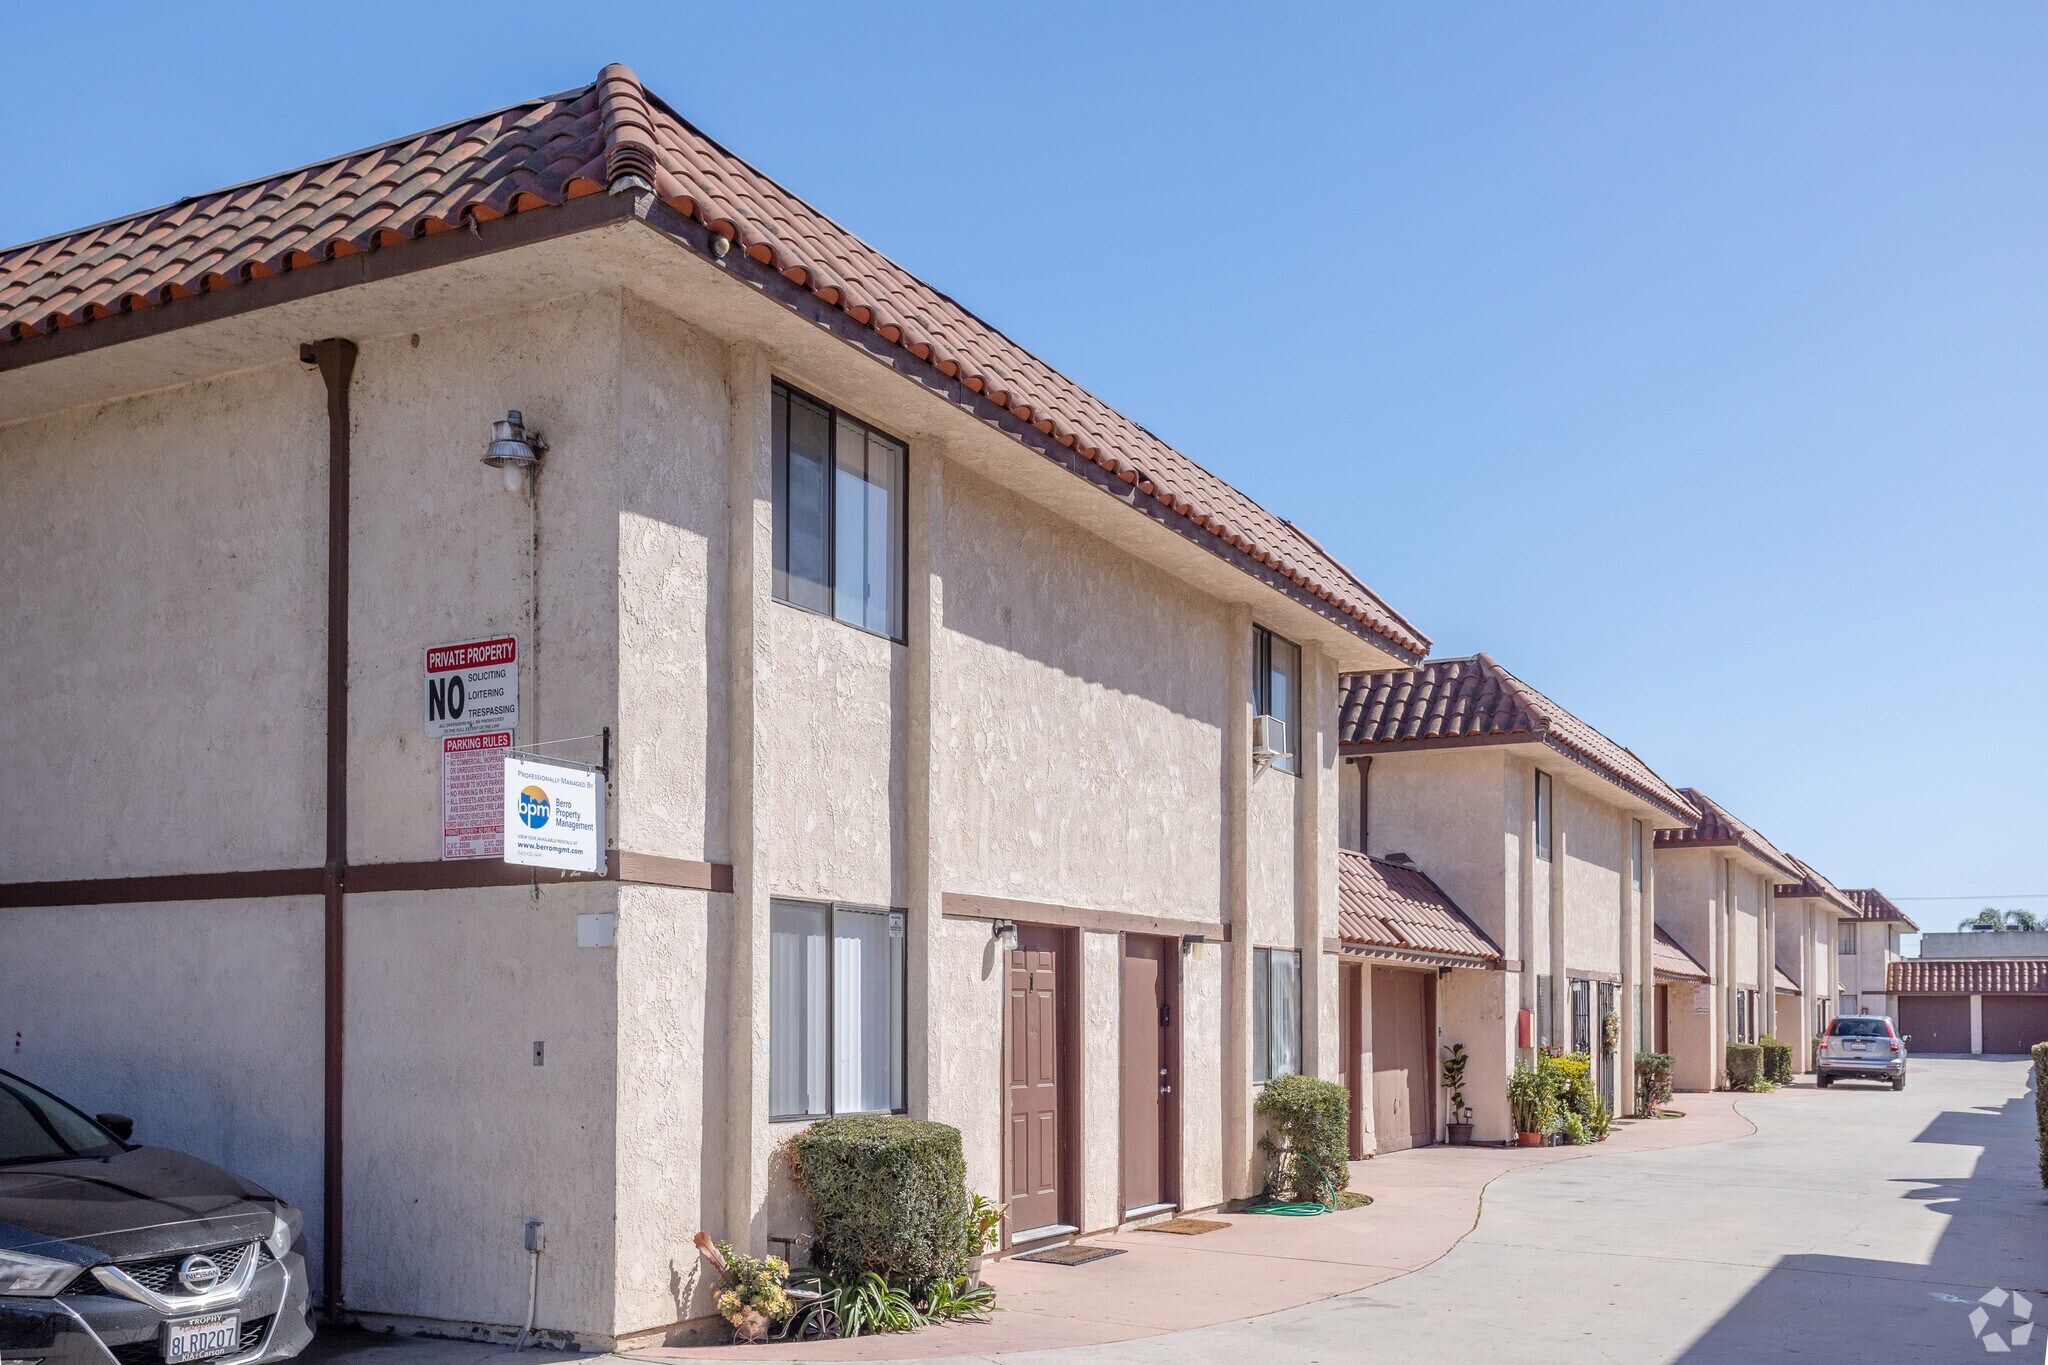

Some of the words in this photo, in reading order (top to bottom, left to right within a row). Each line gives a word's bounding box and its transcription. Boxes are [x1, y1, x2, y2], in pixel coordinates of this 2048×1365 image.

[430, 649, 465, 668] PRIVATE
[468, 642, 514, 664] PROPERTY
[468, 669, 506, 682] SOLICITING
[429, 675, 464, 722] NO
[468, 688, 504, 700] LOITERING
[468, 704, 515, 718] TRESPASSING
[447, 738, 480, 751] PARKING
[483, 735, 508, 748] RULES
[457, 765, 486, 774] UNREGISTERED
[556, 798, 572, 809] Berro
[518, 794, 550, 828] bpm
[556, 808, 581, 821] Property
[556, 818, 594, 831] Management
[517, 842, 583, 854] www.berromgmt.com
[186, 1269, 218, 1280] NISSAN
[189, 1315, 222, 1325] TROPHY
[172, 1328, 234, 1356] 8LRD207
[182, 1352, 195, 1362] KIA
[199, 1348, 225, 1359] Carson
